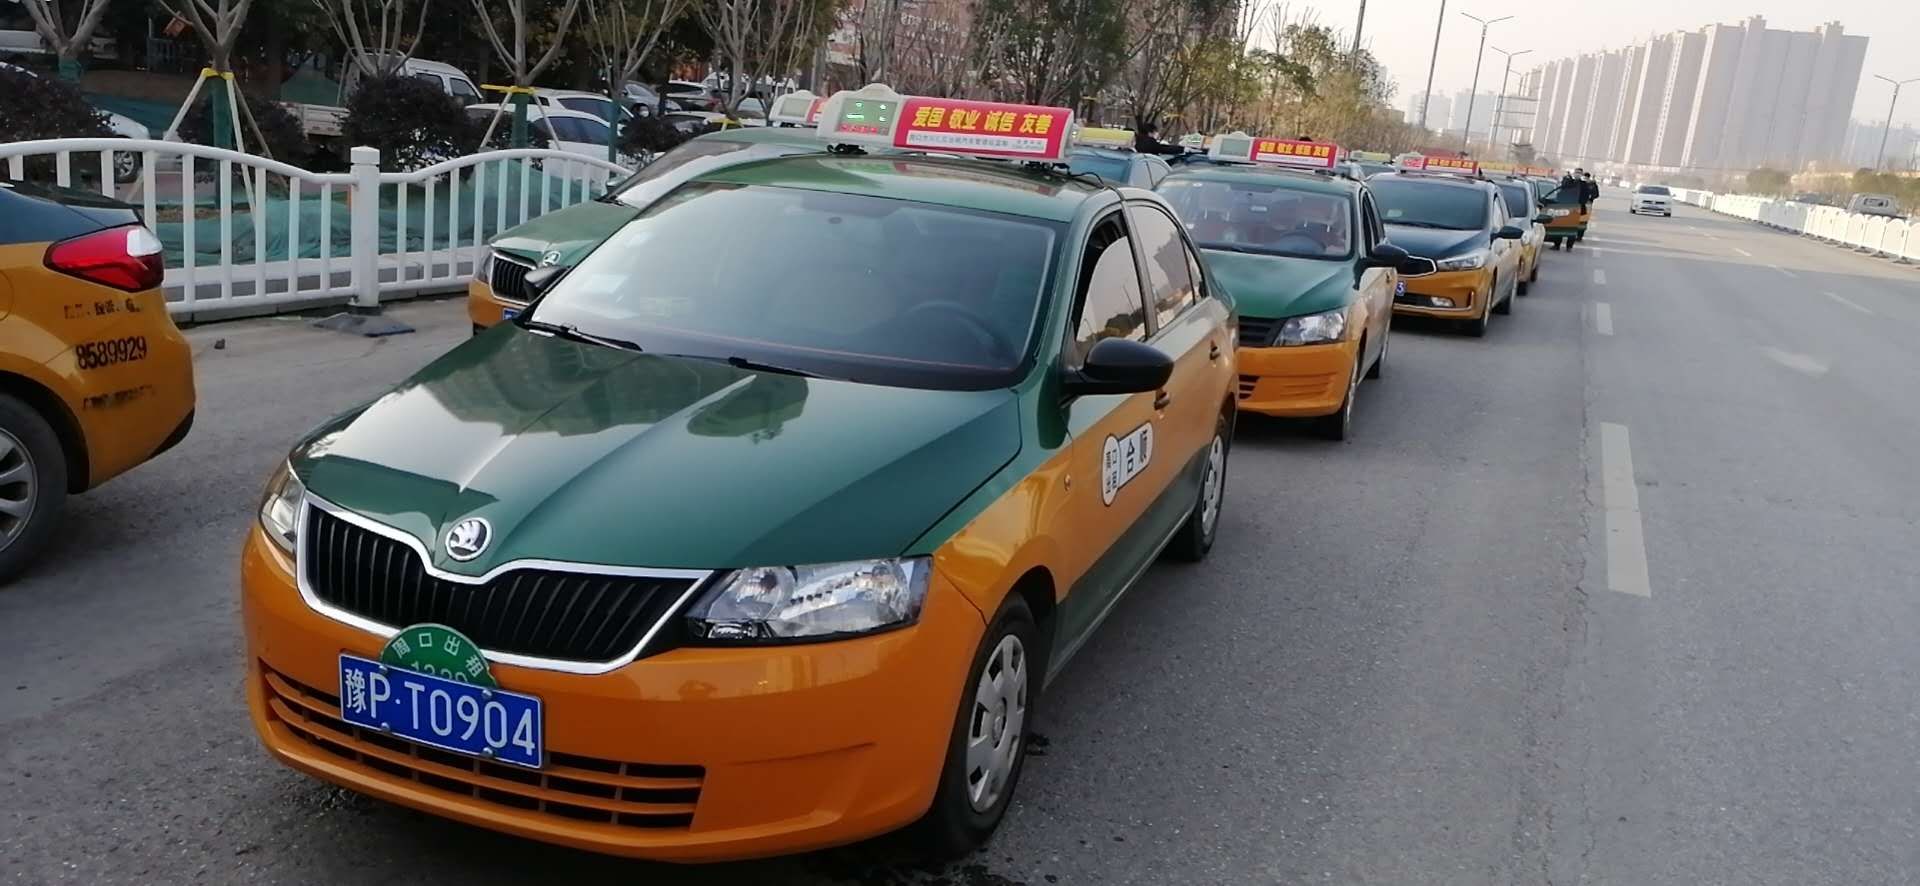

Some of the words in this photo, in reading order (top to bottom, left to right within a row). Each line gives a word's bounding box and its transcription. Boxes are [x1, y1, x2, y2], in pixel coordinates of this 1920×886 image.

[912, 106, 945, 128] 爱国
[949, 108, 980, 130] 敬业
[984, 110, 1017, 132] 诚信
[1019, 113, 1053, 134] 友善
[75, 336, 147, 370] 8589929
[391, 633, 484, 678] 周口出租
